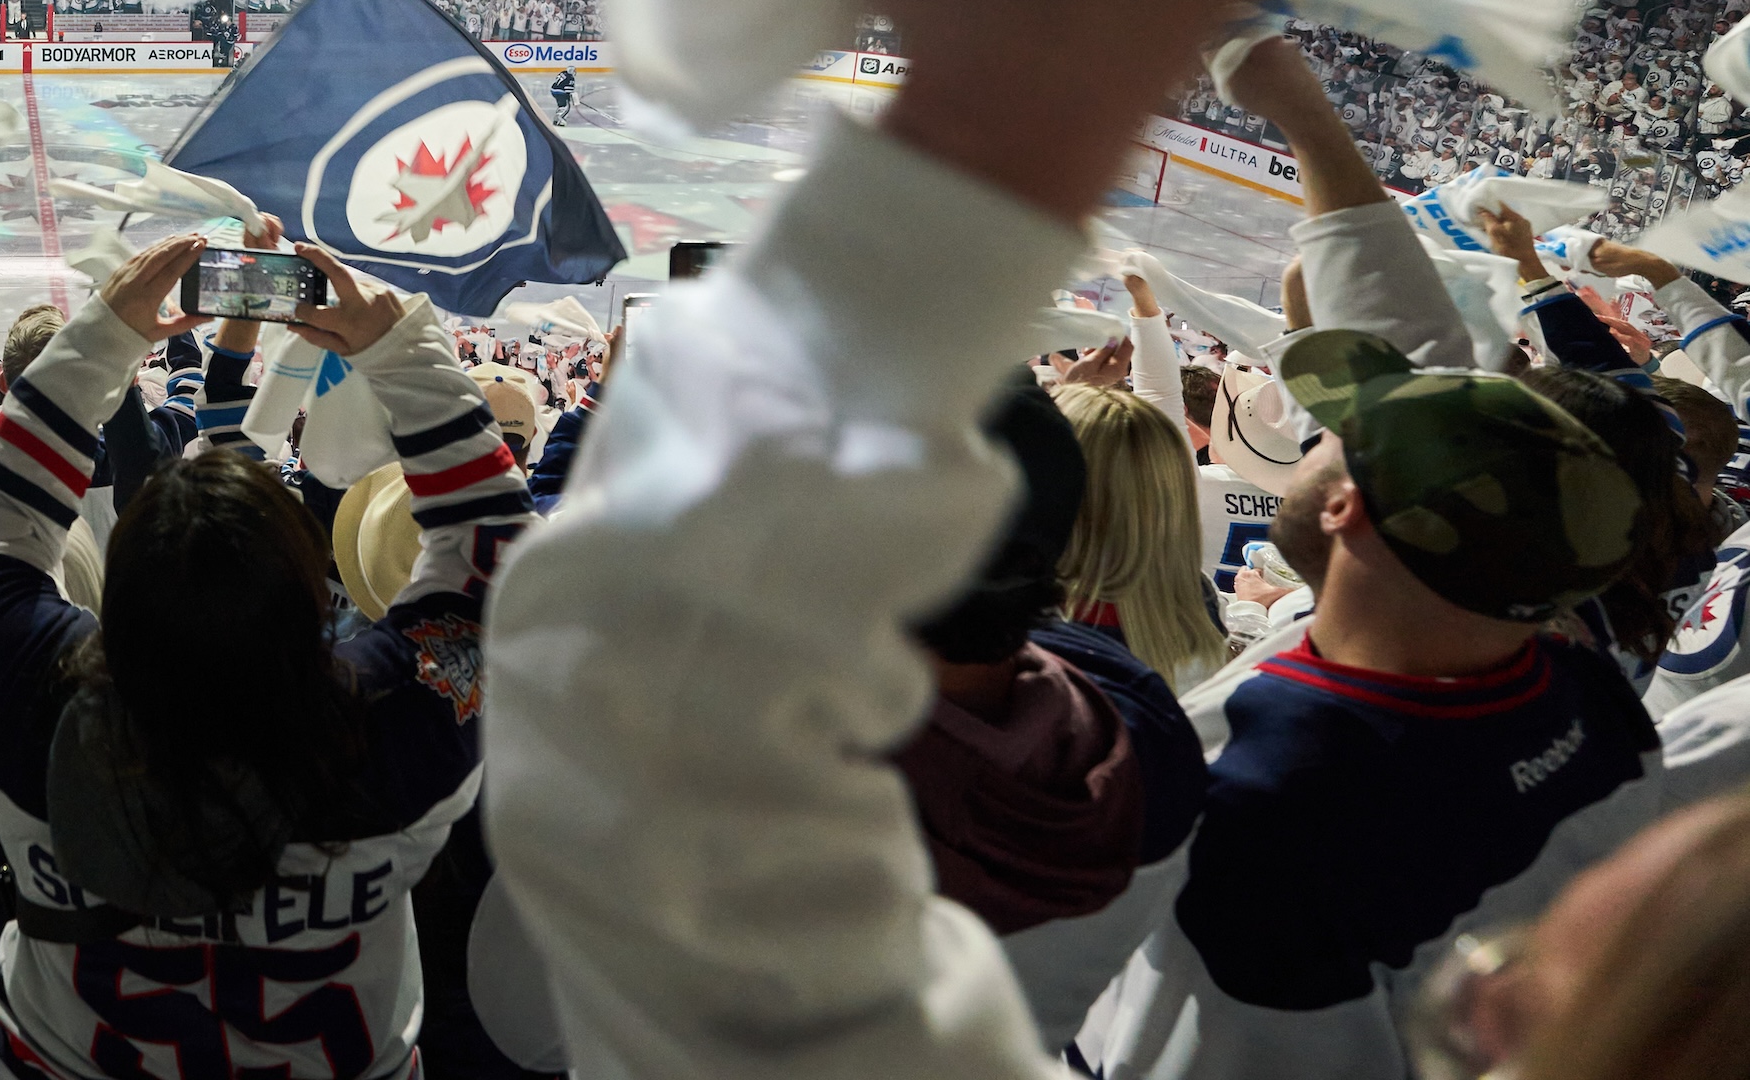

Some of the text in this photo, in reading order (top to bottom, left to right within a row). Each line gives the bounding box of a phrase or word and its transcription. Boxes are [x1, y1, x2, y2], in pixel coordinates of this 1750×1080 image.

[42, 48, 136, 63] BODYARMOR
[509, 46, 598, 61] Esso Medals
[1210, 142, 1258, 168] ULTRA
[1509, 718, 1587, 795] Reebok
